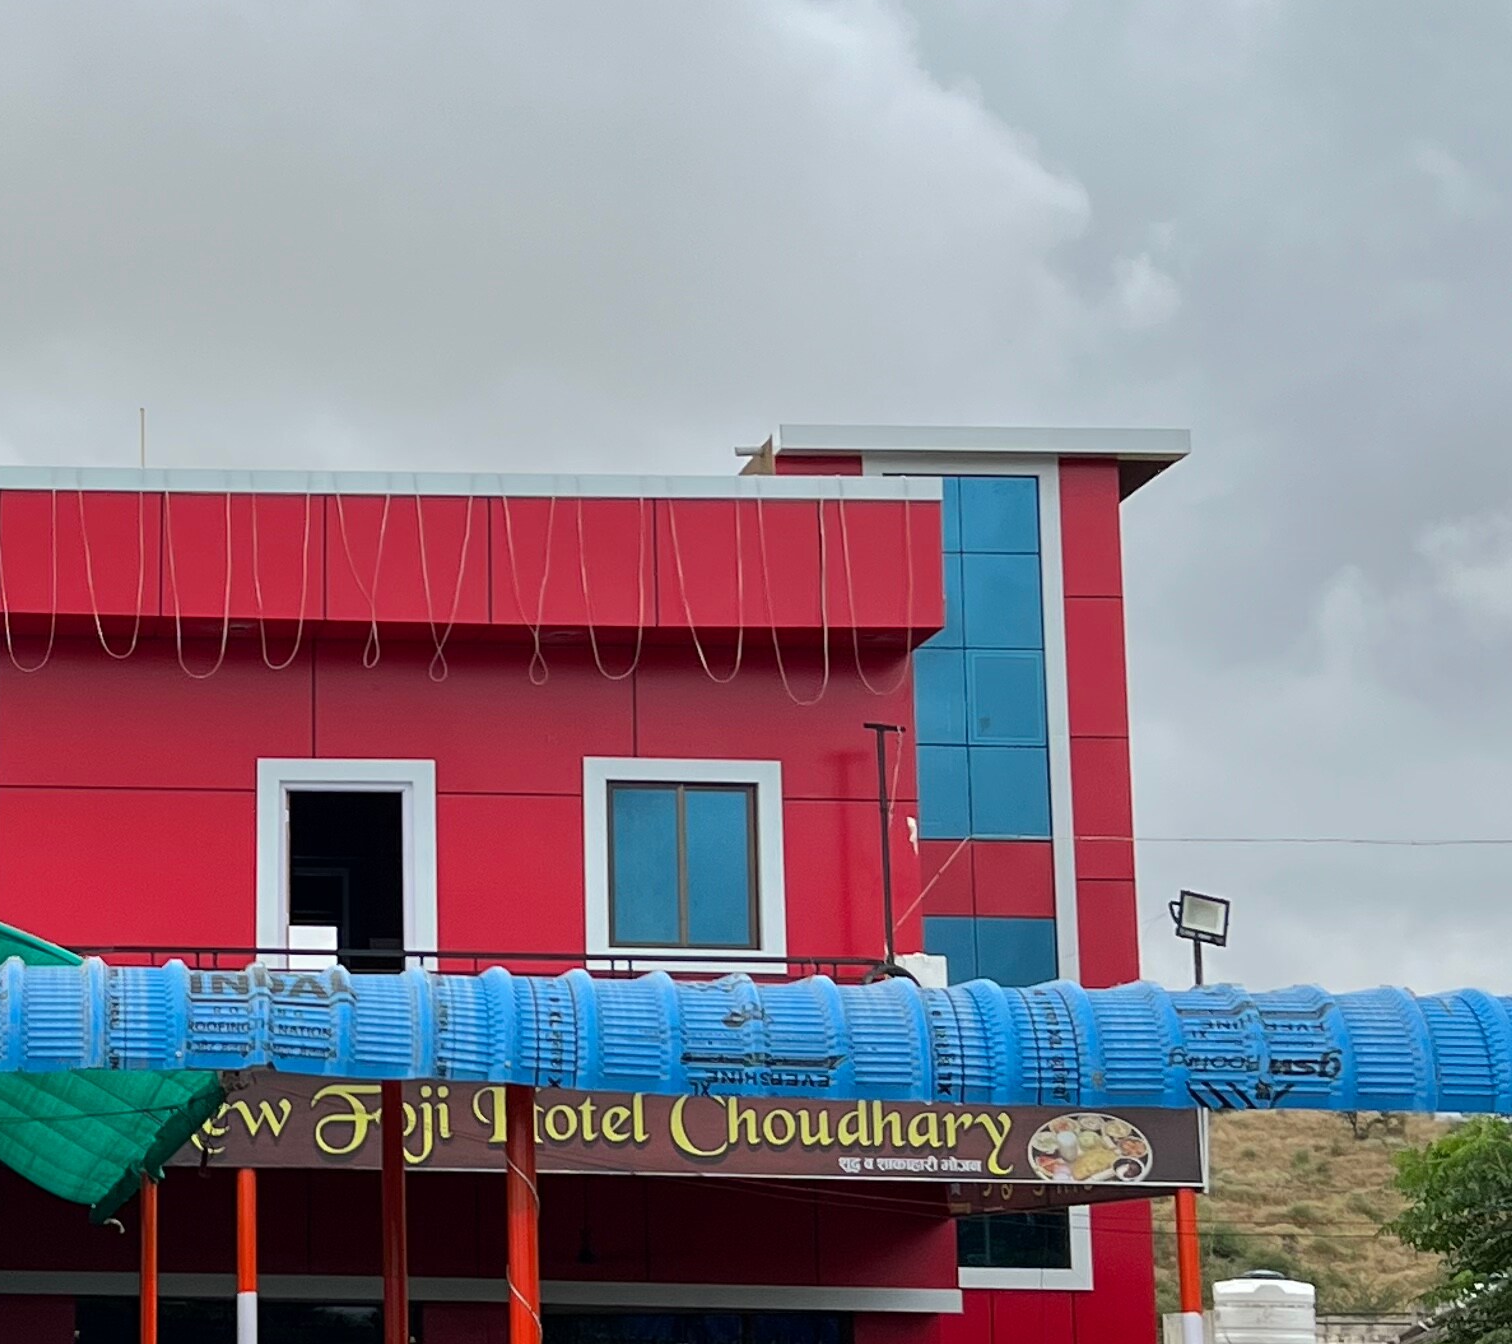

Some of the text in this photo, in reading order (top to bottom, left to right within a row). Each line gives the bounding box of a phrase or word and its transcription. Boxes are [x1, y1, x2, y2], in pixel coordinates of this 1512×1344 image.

[188, 968, 358, 999] INDAL
[704, 1070, 831, 1088] EVERSHINE
[191, 1098, 293, 1154] ew
[669, 1093, 1014, 1176] Choudhary
